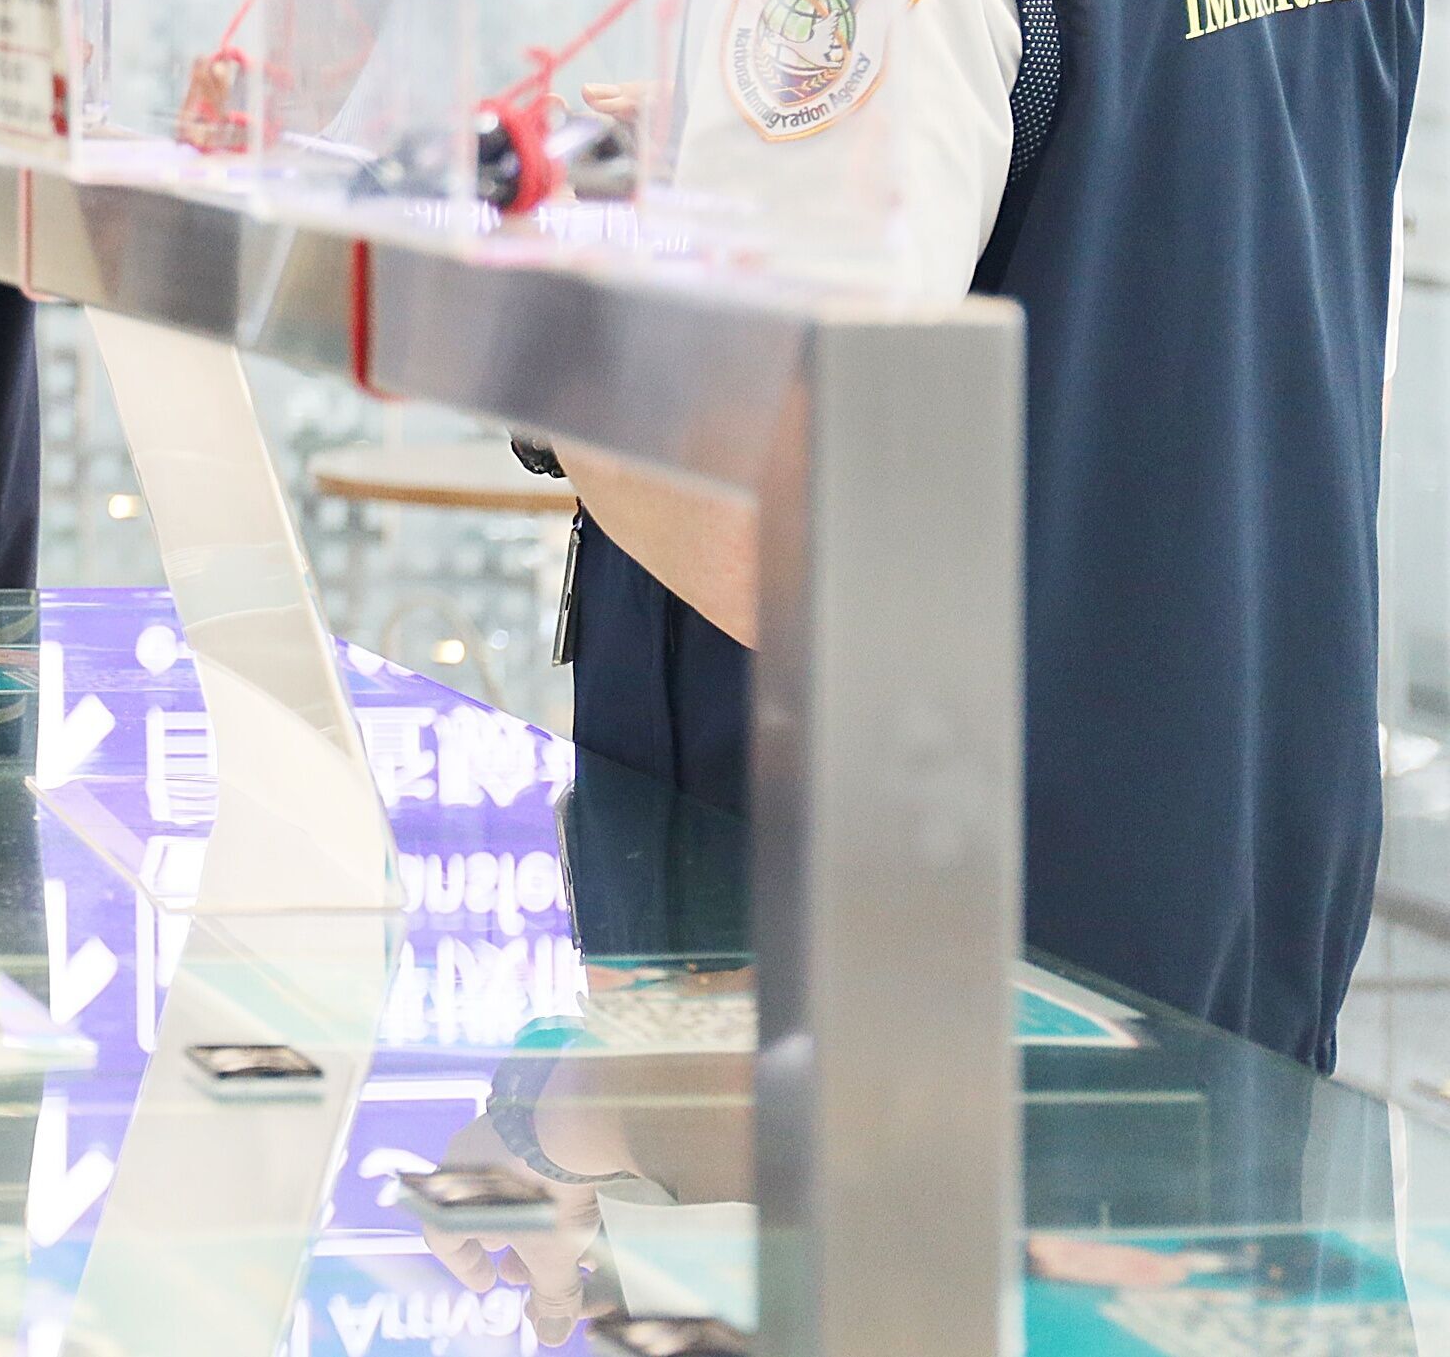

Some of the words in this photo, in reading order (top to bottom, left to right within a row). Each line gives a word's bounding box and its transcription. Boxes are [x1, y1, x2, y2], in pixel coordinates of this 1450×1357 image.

[733, 27, 754, 91] National
[745, 82, 830, 130] Immigration
[830, 52, 872, 110] Agency
